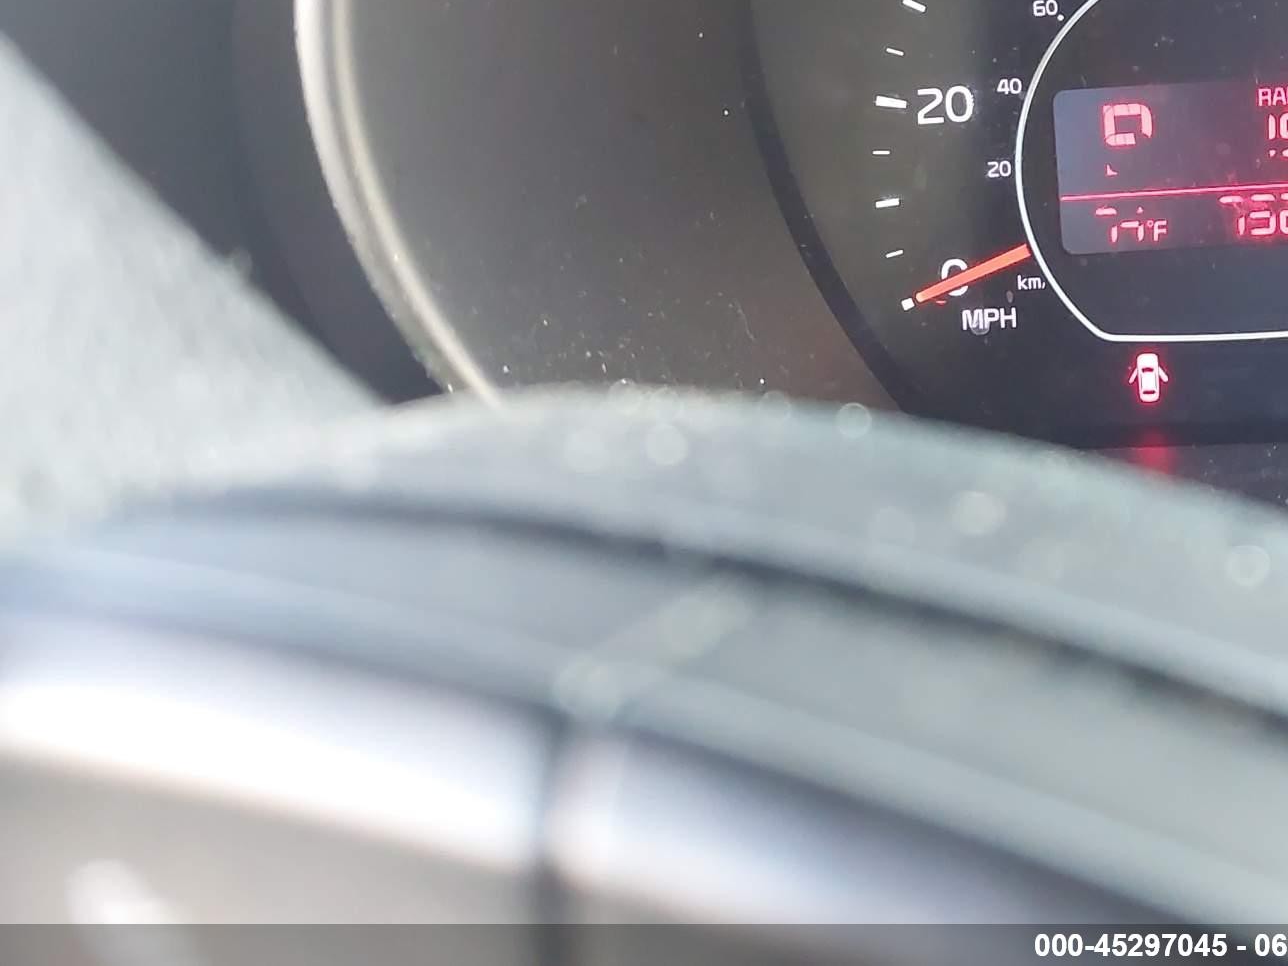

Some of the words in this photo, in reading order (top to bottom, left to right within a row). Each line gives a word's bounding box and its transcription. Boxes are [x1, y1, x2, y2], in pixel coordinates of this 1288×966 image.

[1032, 0, 1059, 17] 60
[996, 77, 1022, 95] 40
[917, 85, 975, 125] 20
[987, 159, 1013, 178] 20
[961, 306, 1018, 332] MPH
